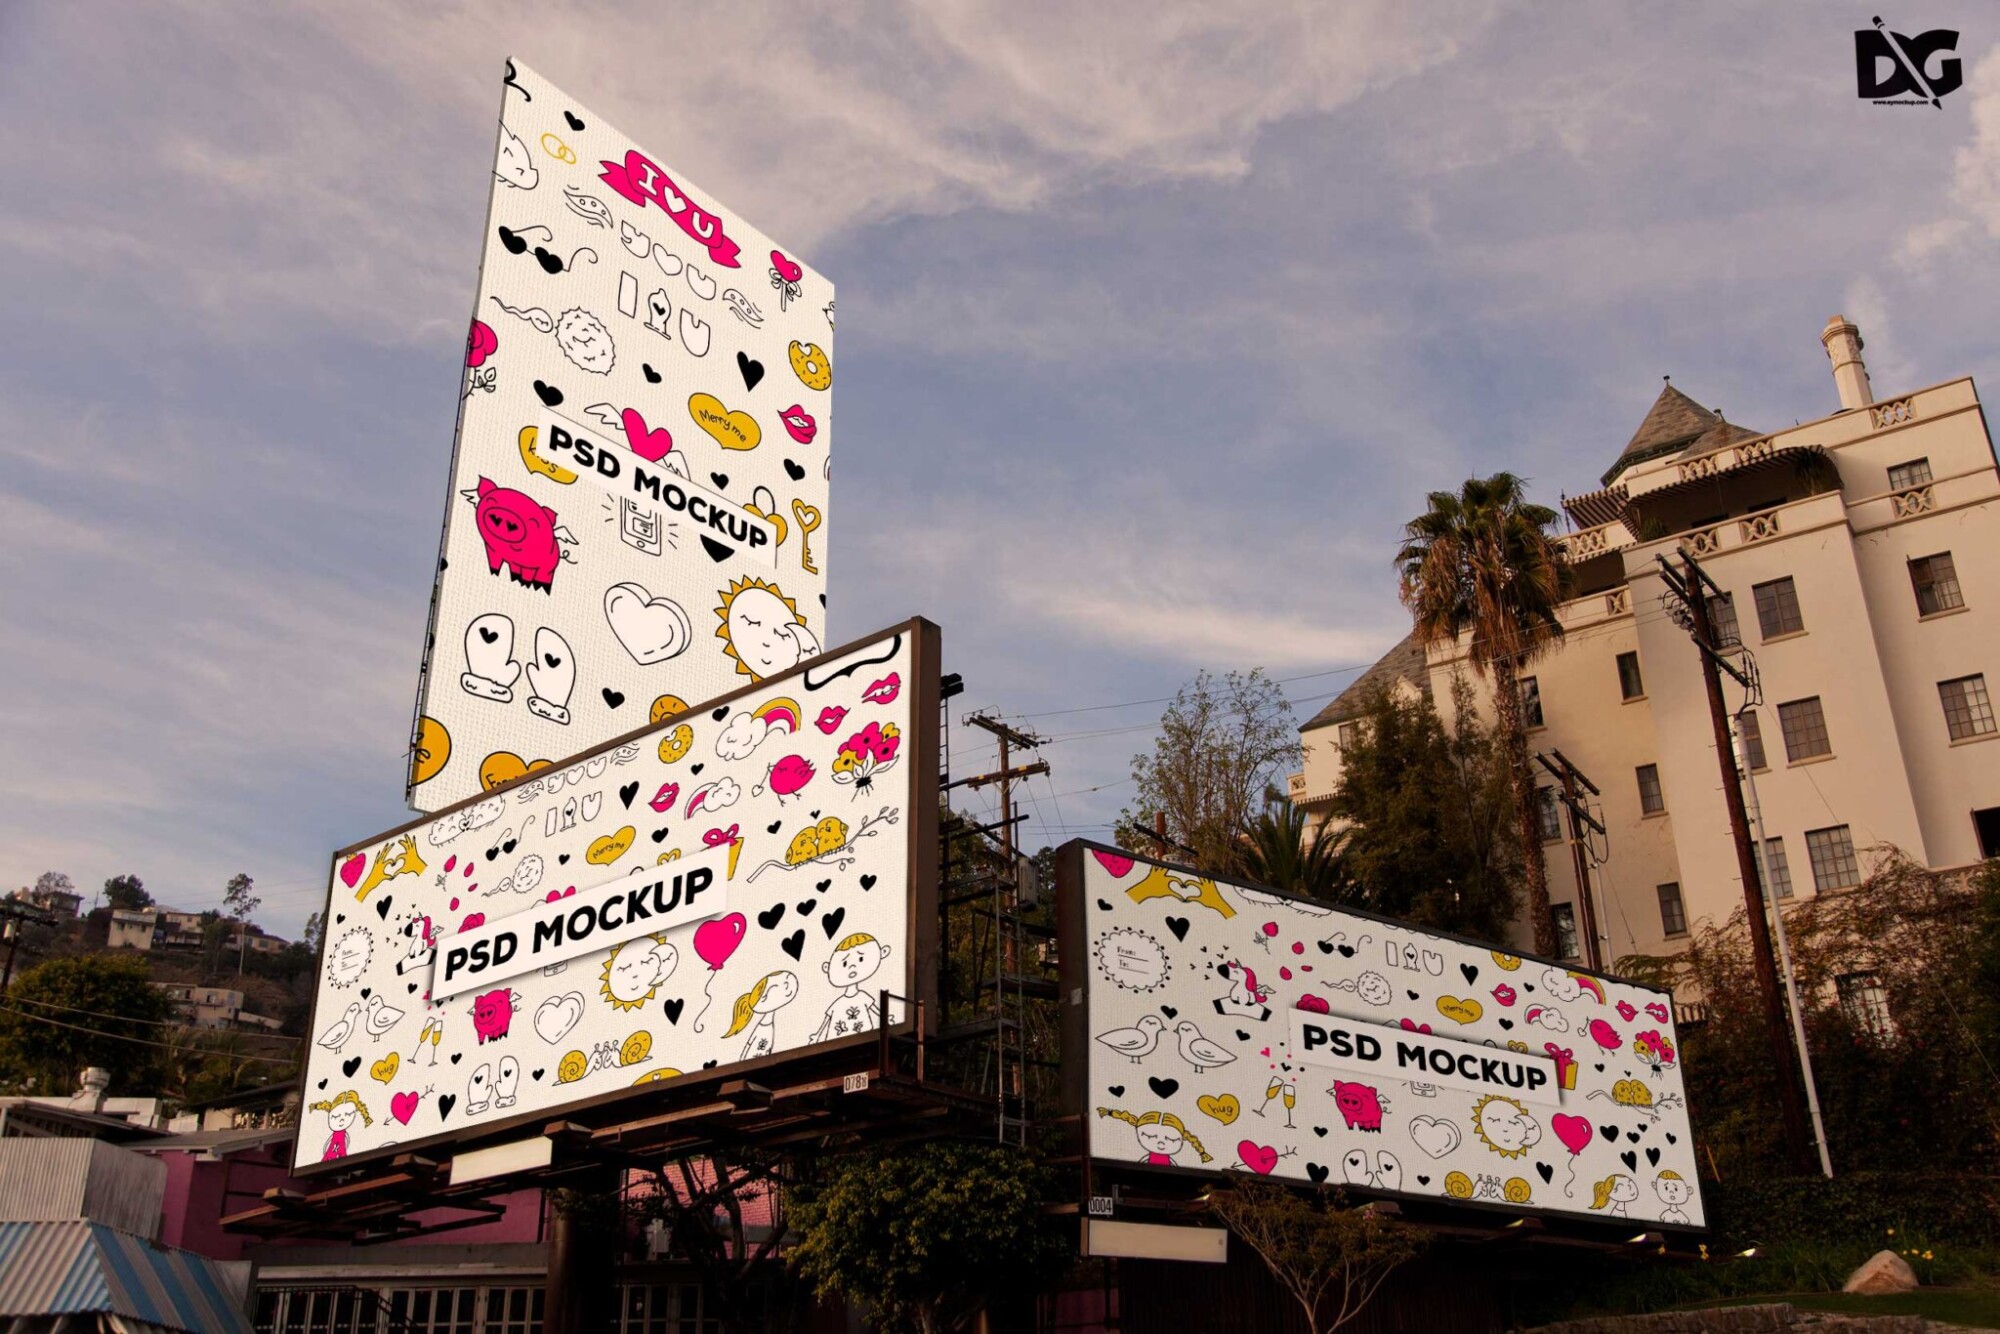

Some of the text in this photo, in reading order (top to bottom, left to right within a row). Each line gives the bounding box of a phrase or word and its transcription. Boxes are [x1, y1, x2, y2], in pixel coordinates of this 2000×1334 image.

[638, 162, 714, 239] I U
[699, 409, 747, 442] Merry me
[549, 424, 768, 549] PSD MOCKUP
[592, 842, 614, 860] Merry
[445, 866, 713, 982] PSD MOCKUP
[1443, 1004, 1463, 1014] Merry
[1302, 1023, 1548, 1091] PSD MOCKUP
[1207, 1103, 1233, 1117] hug
